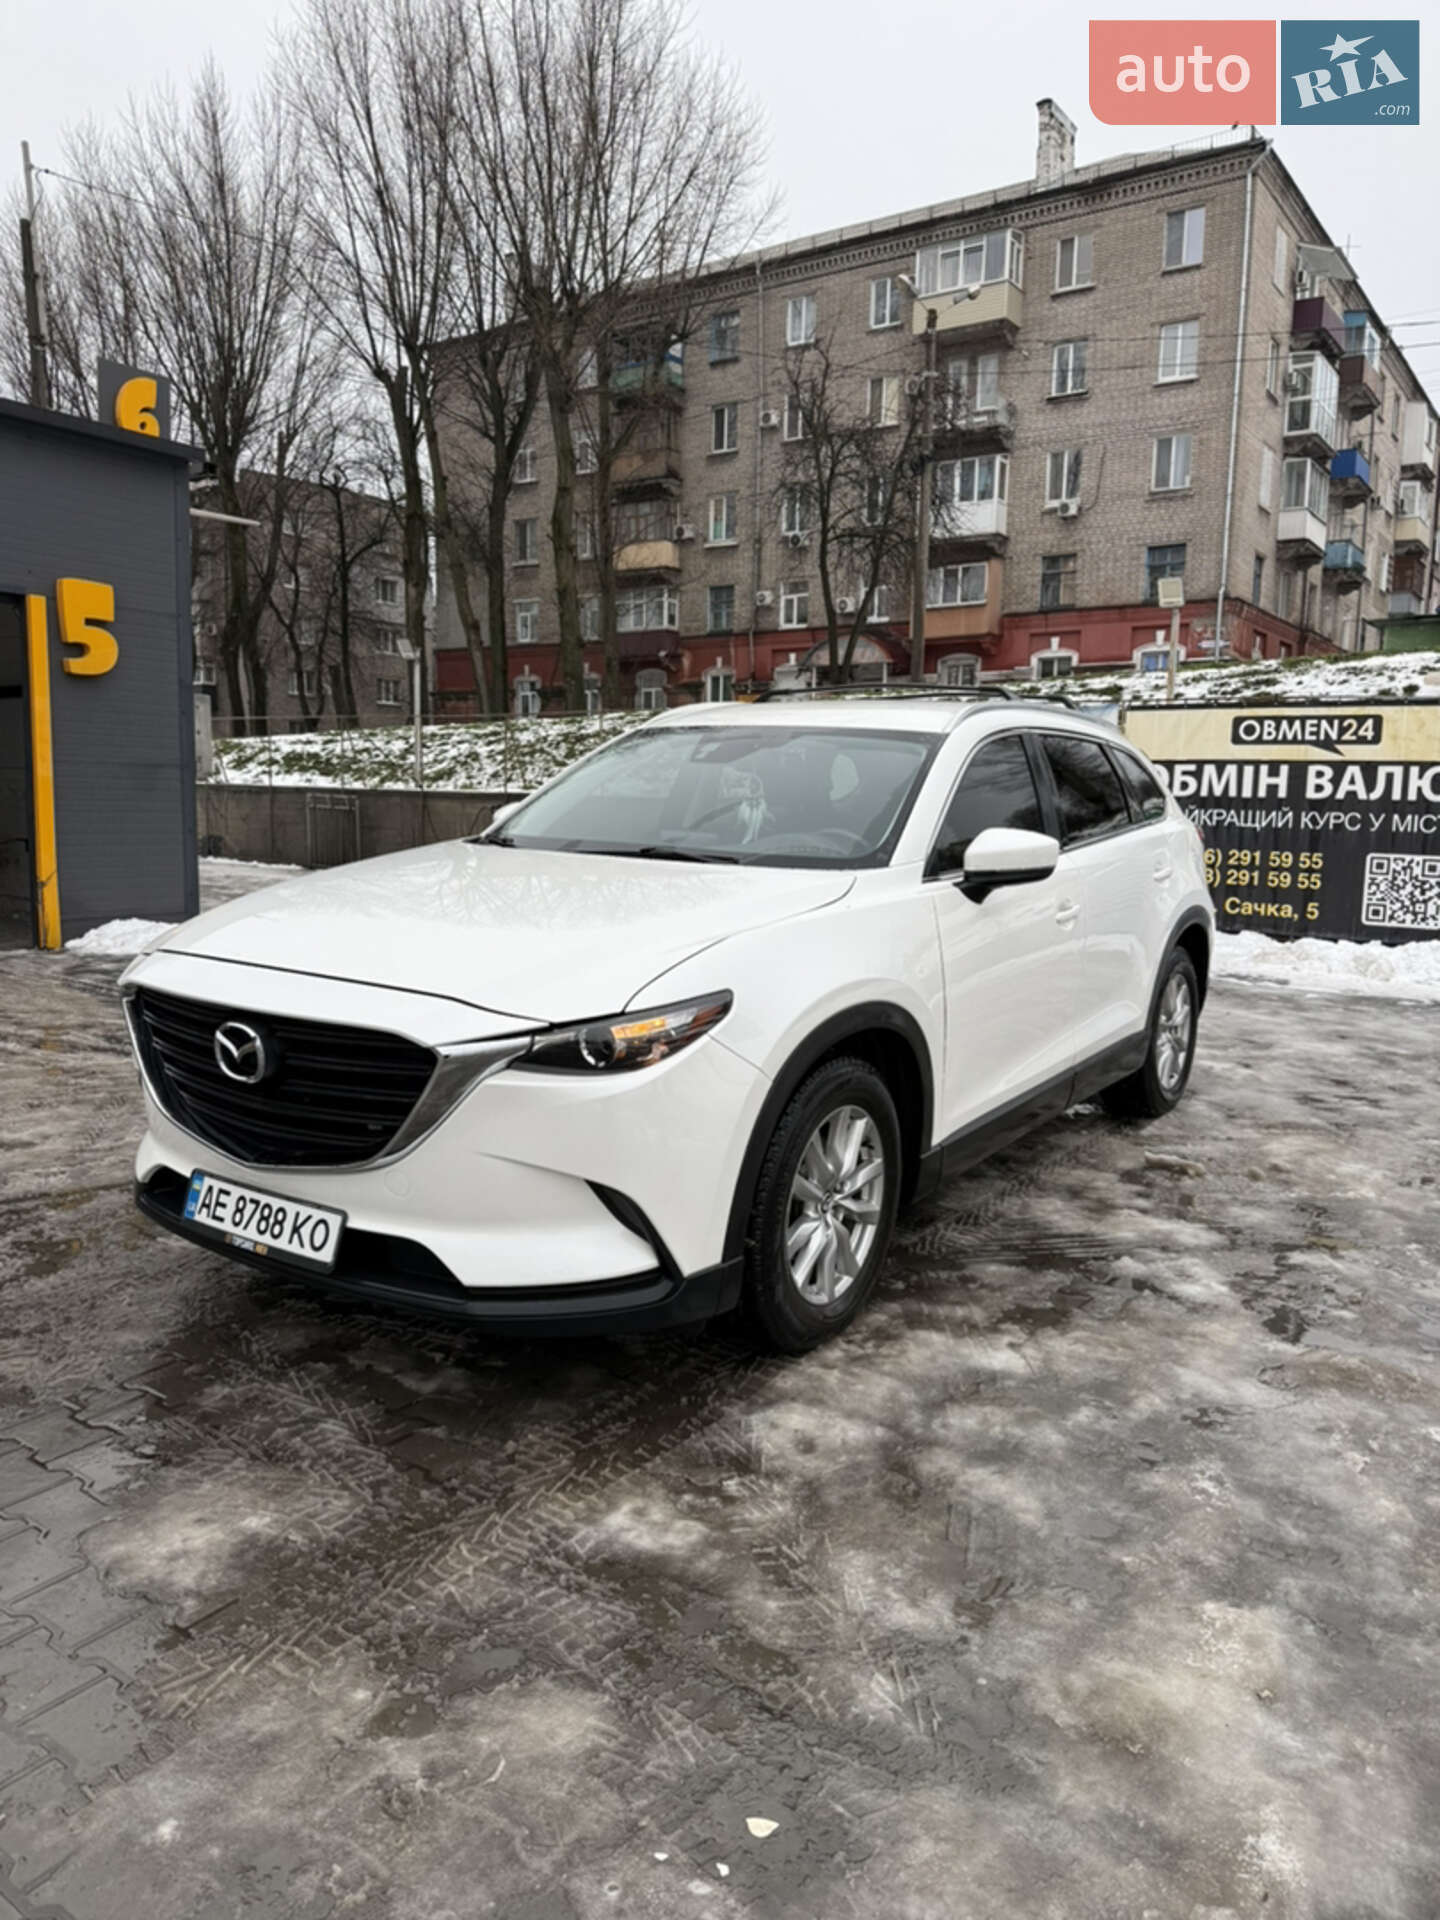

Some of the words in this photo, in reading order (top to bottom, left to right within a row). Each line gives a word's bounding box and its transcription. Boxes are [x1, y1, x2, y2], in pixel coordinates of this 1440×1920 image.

[115, 376, 160, 438] 6
[56, 577, 119, 676] 5
[1238, 718, 1375, 742] OBMEN24
[1305, 764, 1440, 802] ВАЛЮ
[1300, 810, 1362, 831] КУРС
[1368, 812, 1386, 832] У
[1391, 812, 1440, 834] МІС
[1227, 848, 1261, 866] 291
[1268, 850, 1293, 868] 59
[1298, 852, 1324, 869] 55
[1225, 868, 1260, 886] 291
[1267, 871, 1292, 888] 59
[1297, 872, 1322, 890] 55
[1224, 896, 1299, 921] Сачка,
[1305, 902, 1320, 920] 5
[198, 1184, 231, 1223] AE
[231, 1195, 287, 1240] 8788
[288, 1211, 330, 1252] KO
